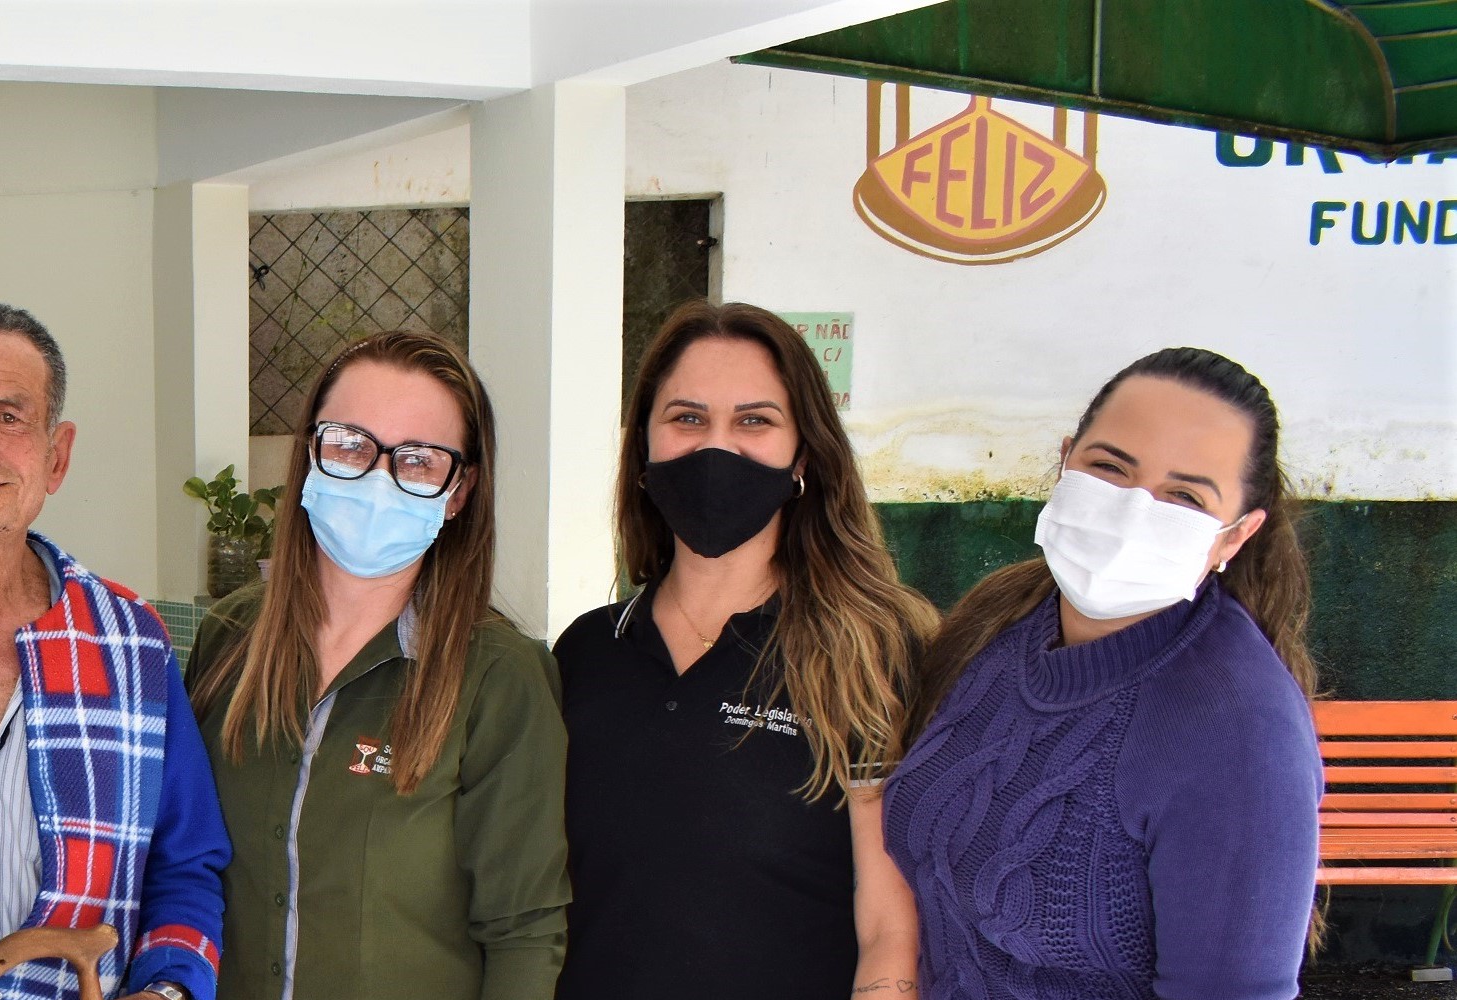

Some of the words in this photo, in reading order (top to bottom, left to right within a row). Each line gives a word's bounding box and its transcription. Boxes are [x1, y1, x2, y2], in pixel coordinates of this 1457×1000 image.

[901, 115, 1056, 230] FELIZ
[1309, 200, 1457, 246] FUND
[719, 702, 750, 715] Poder
[725, 715, 763, 728] Domingos
[766, 720, 797, 736] Martins
